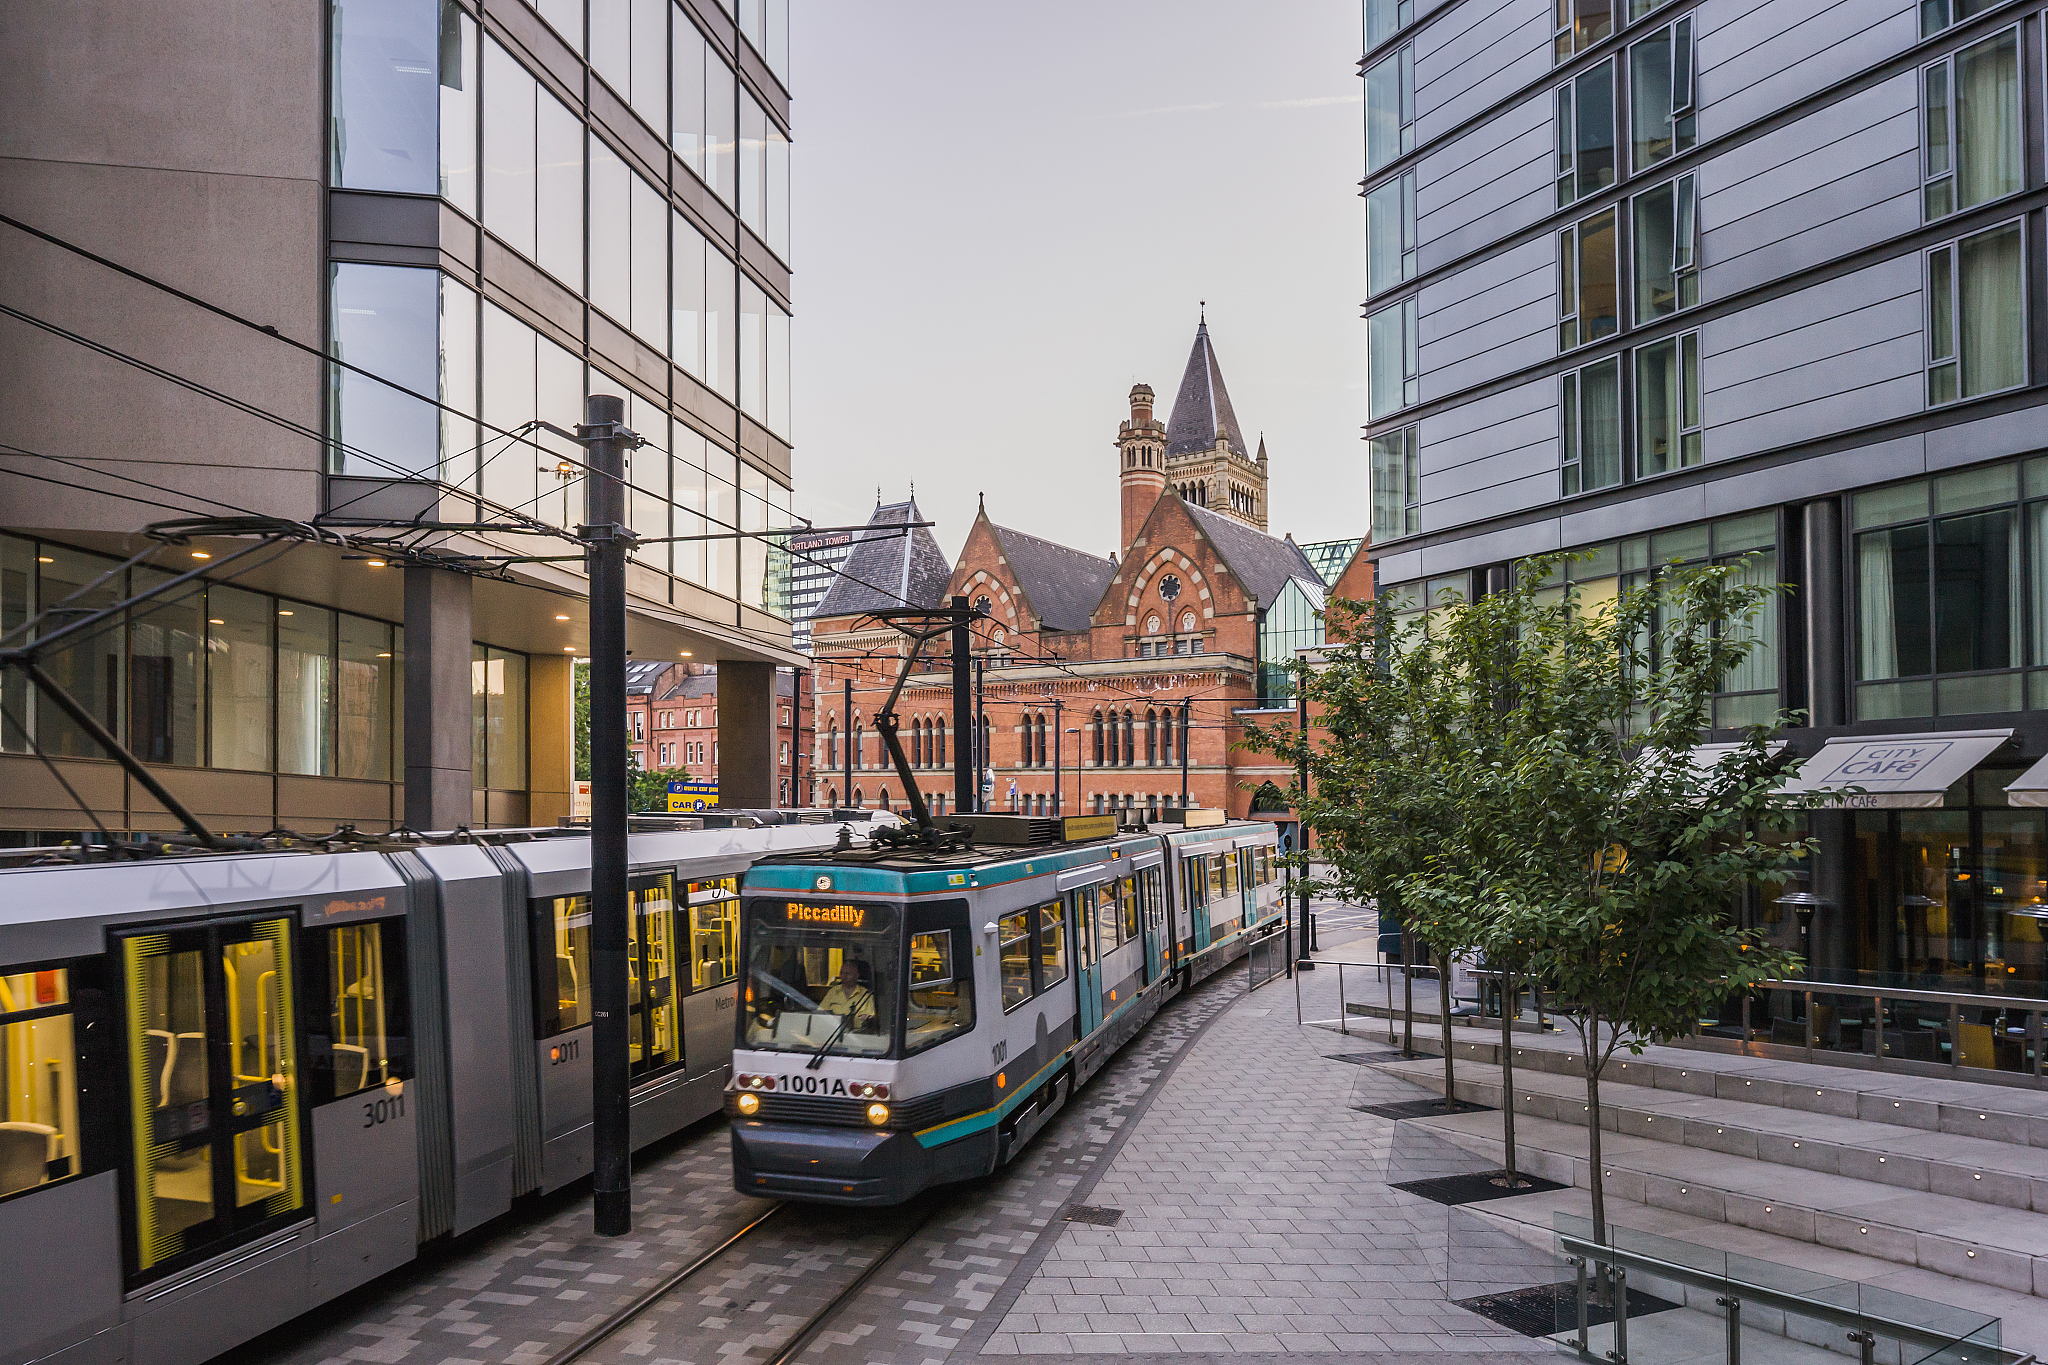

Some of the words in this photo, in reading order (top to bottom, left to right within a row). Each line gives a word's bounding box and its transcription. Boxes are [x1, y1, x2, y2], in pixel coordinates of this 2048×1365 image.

[791, 539, 823, 551] ORTLAND
[824, 535, 850, 546] TOWER
[1868, 748, 1926, 759] CITY
[1842, 760, 1921, 775] CAFé
[672, 801, 692, 809] CAR
[1851, 795, 1878, 808] CAFé
[787, 903, 864, 927] Piccadilly
[992, 1039, 1008, 1067] 1001
[779, 1075, 848, 1096] 1001A
[363, 1094, 405, 1129] 3011
